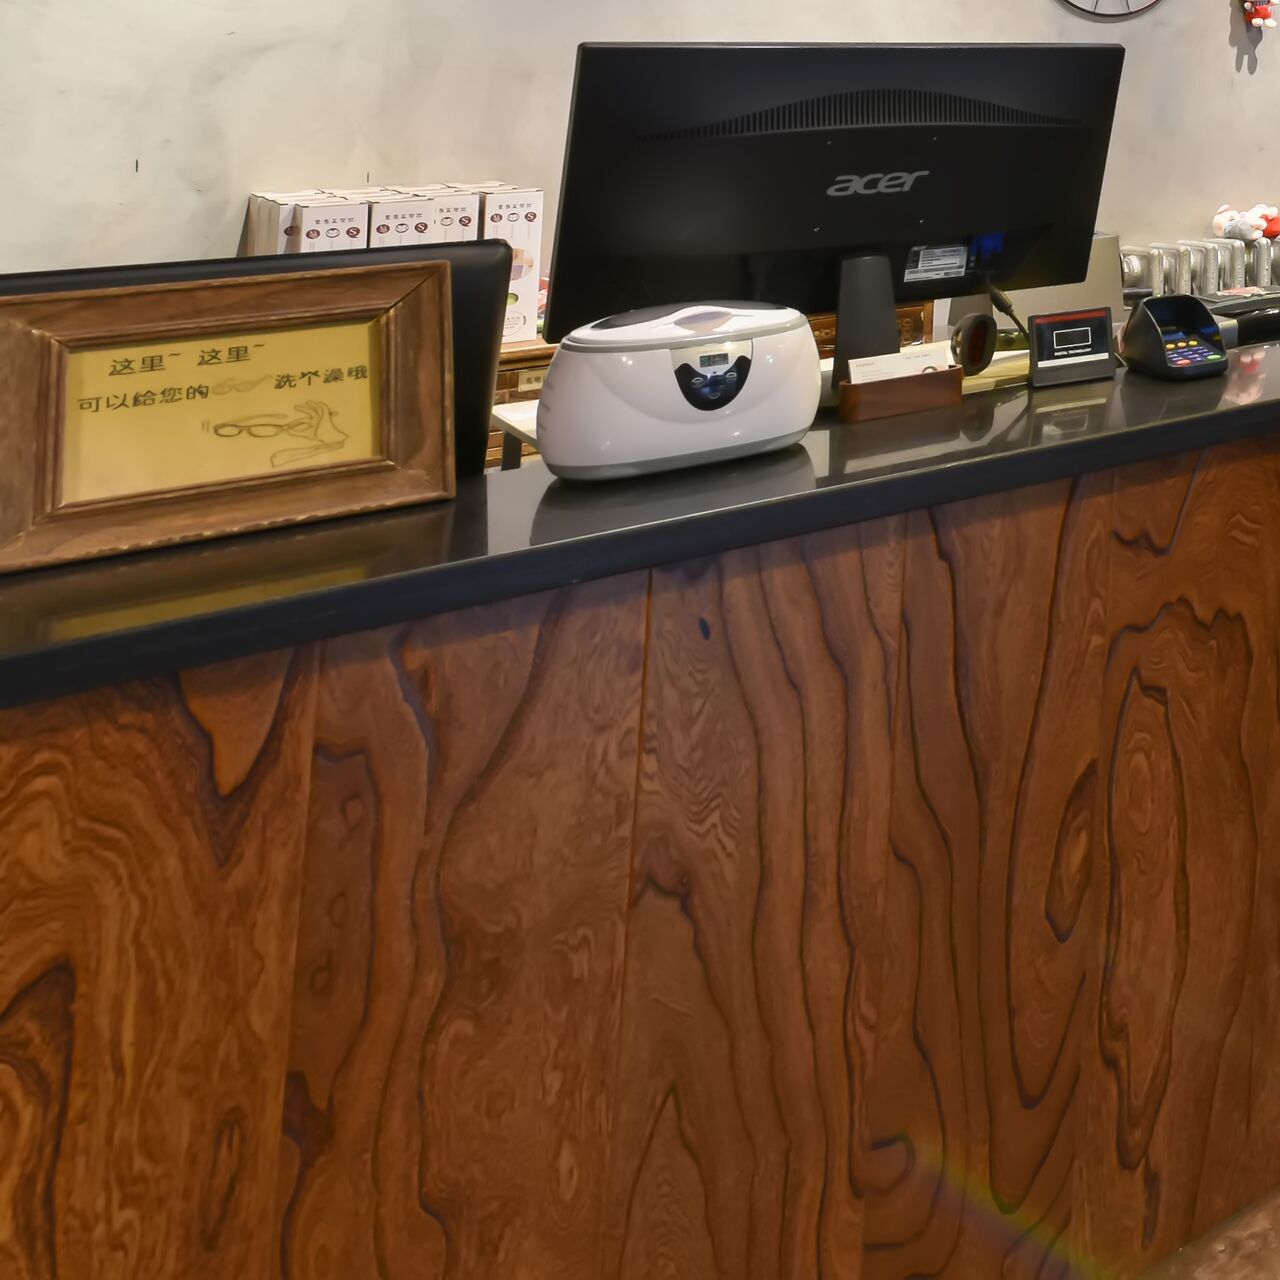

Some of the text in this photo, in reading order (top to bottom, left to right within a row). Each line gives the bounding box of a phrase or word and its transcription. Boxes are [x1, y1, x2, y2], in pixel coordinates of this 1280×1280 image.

[826, 170, 930, 197] acer
[77, 383, 210, 413] 可以给您的
